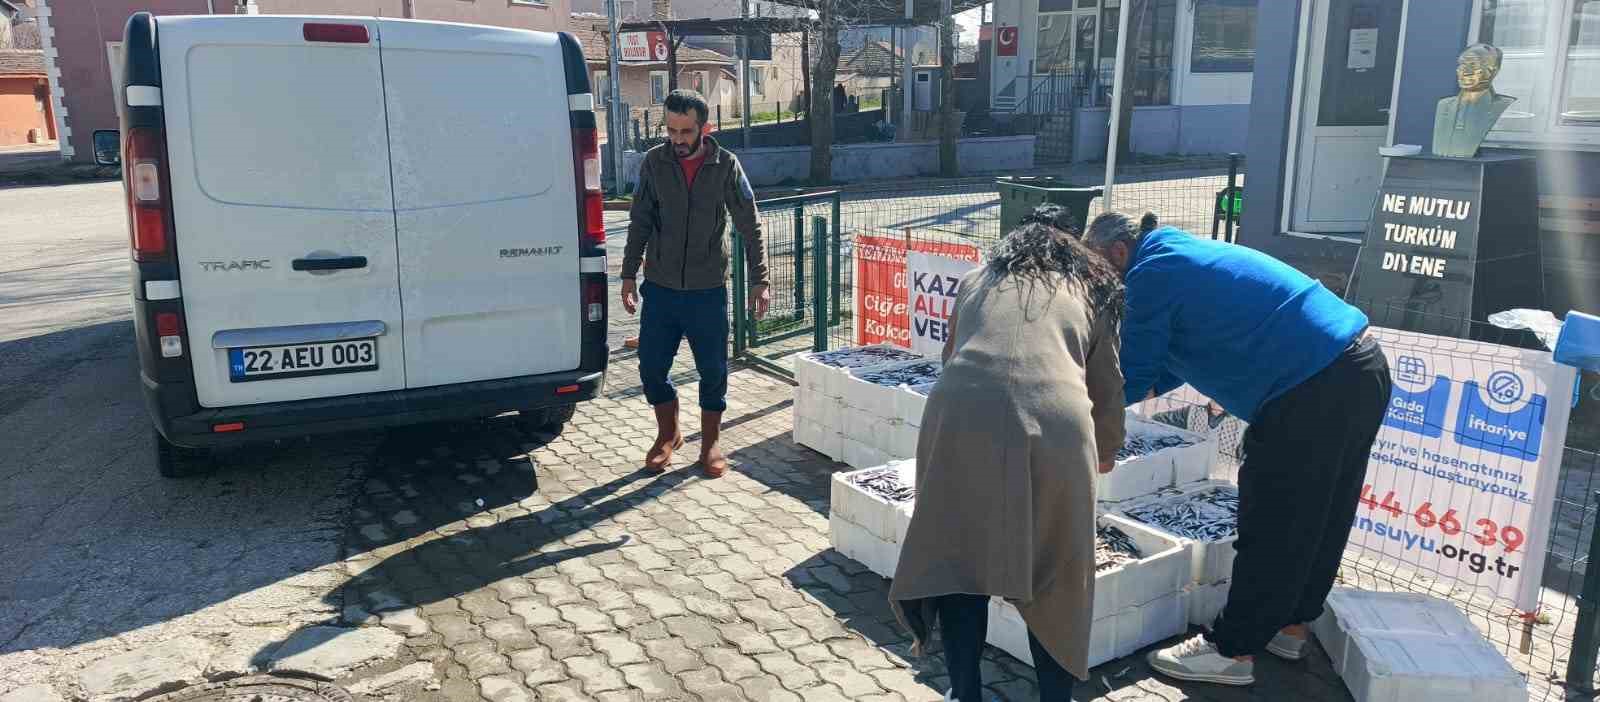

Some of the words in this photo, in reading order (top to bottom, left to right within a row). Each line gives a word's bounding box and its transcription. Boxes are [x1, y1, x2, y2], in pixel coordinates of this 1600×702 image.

[1382, 193, 1406, 214] NE
[1408, 196, 1471, 220] MUTLU
[199, 259, 273, 272] TRAFIC
[499, 246, 563, 258] RENAULT
[914, 271, 959, 298] KAZ
[244, 350, 274, 372] 22
[281, 345, 324, 369] AEU
[332, 342, 373, 365] 003
[1401, 445, 1418, 456] ve
[1414, 502, 1461, 536] 66
[1474, 518, 1524, 554] 39
